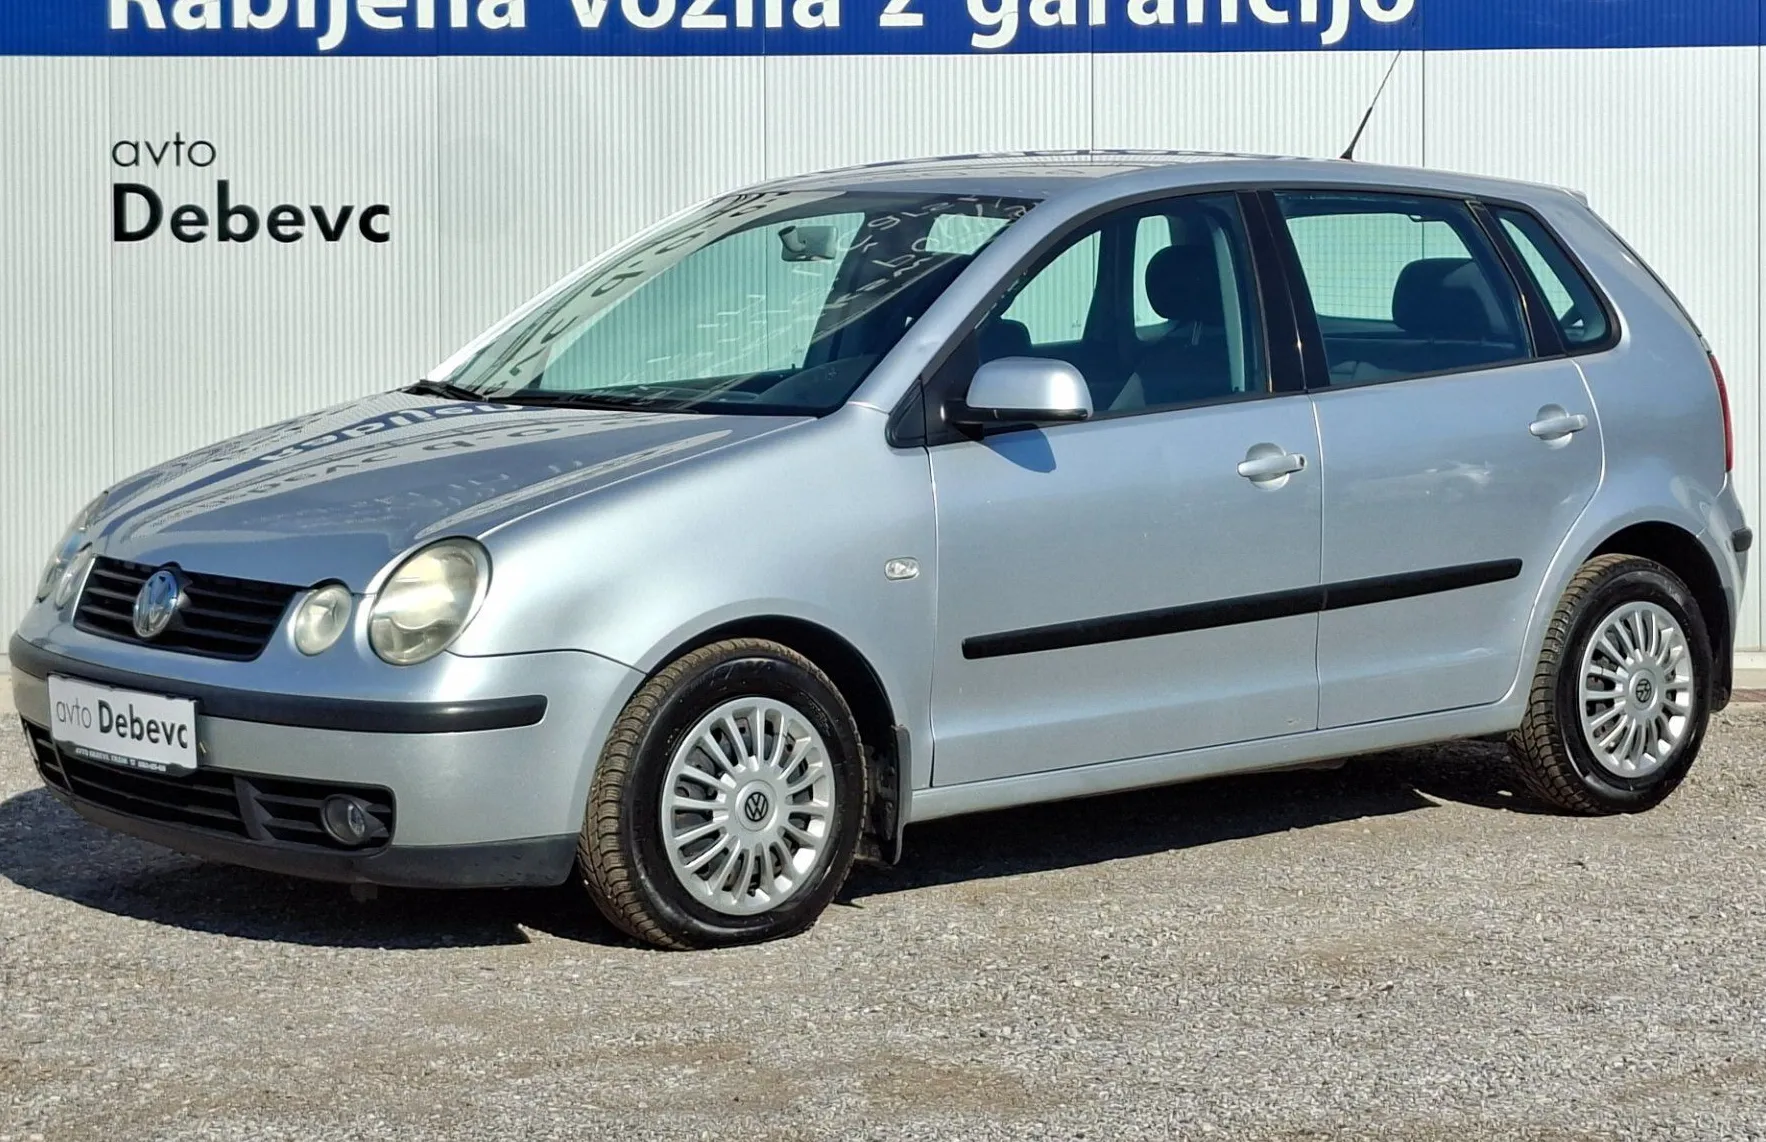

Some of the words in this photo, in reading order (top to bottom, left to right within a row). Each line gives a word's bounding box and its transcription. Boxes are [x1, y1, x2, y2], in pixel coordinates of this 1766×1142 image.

[111, 132, 217, 168] avto
[112, 179, 390, 244] Debevc
[56, 697, 93, 729] avto
[97, 699, 189, 749] Debevc
[744, 791, 769, 822] VW
